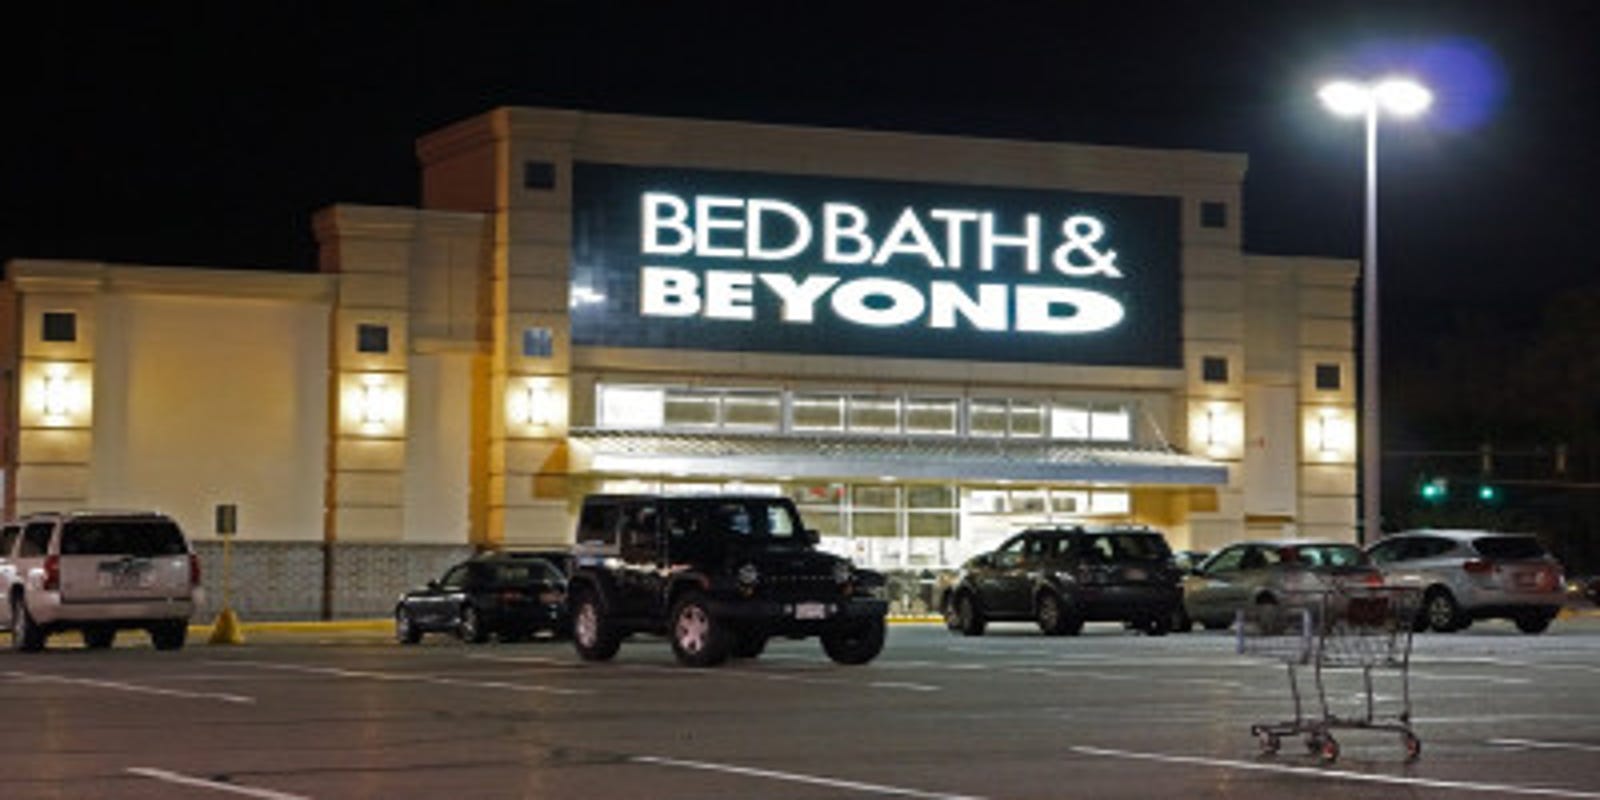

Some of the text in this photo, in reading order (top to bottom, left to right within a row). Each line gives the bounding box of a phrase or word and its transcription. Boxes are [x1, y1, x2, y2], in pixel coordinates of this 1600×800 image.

[641, 192, 1123, 278] BED BATH &
[640, 266, 1126, 334] BEYOND
